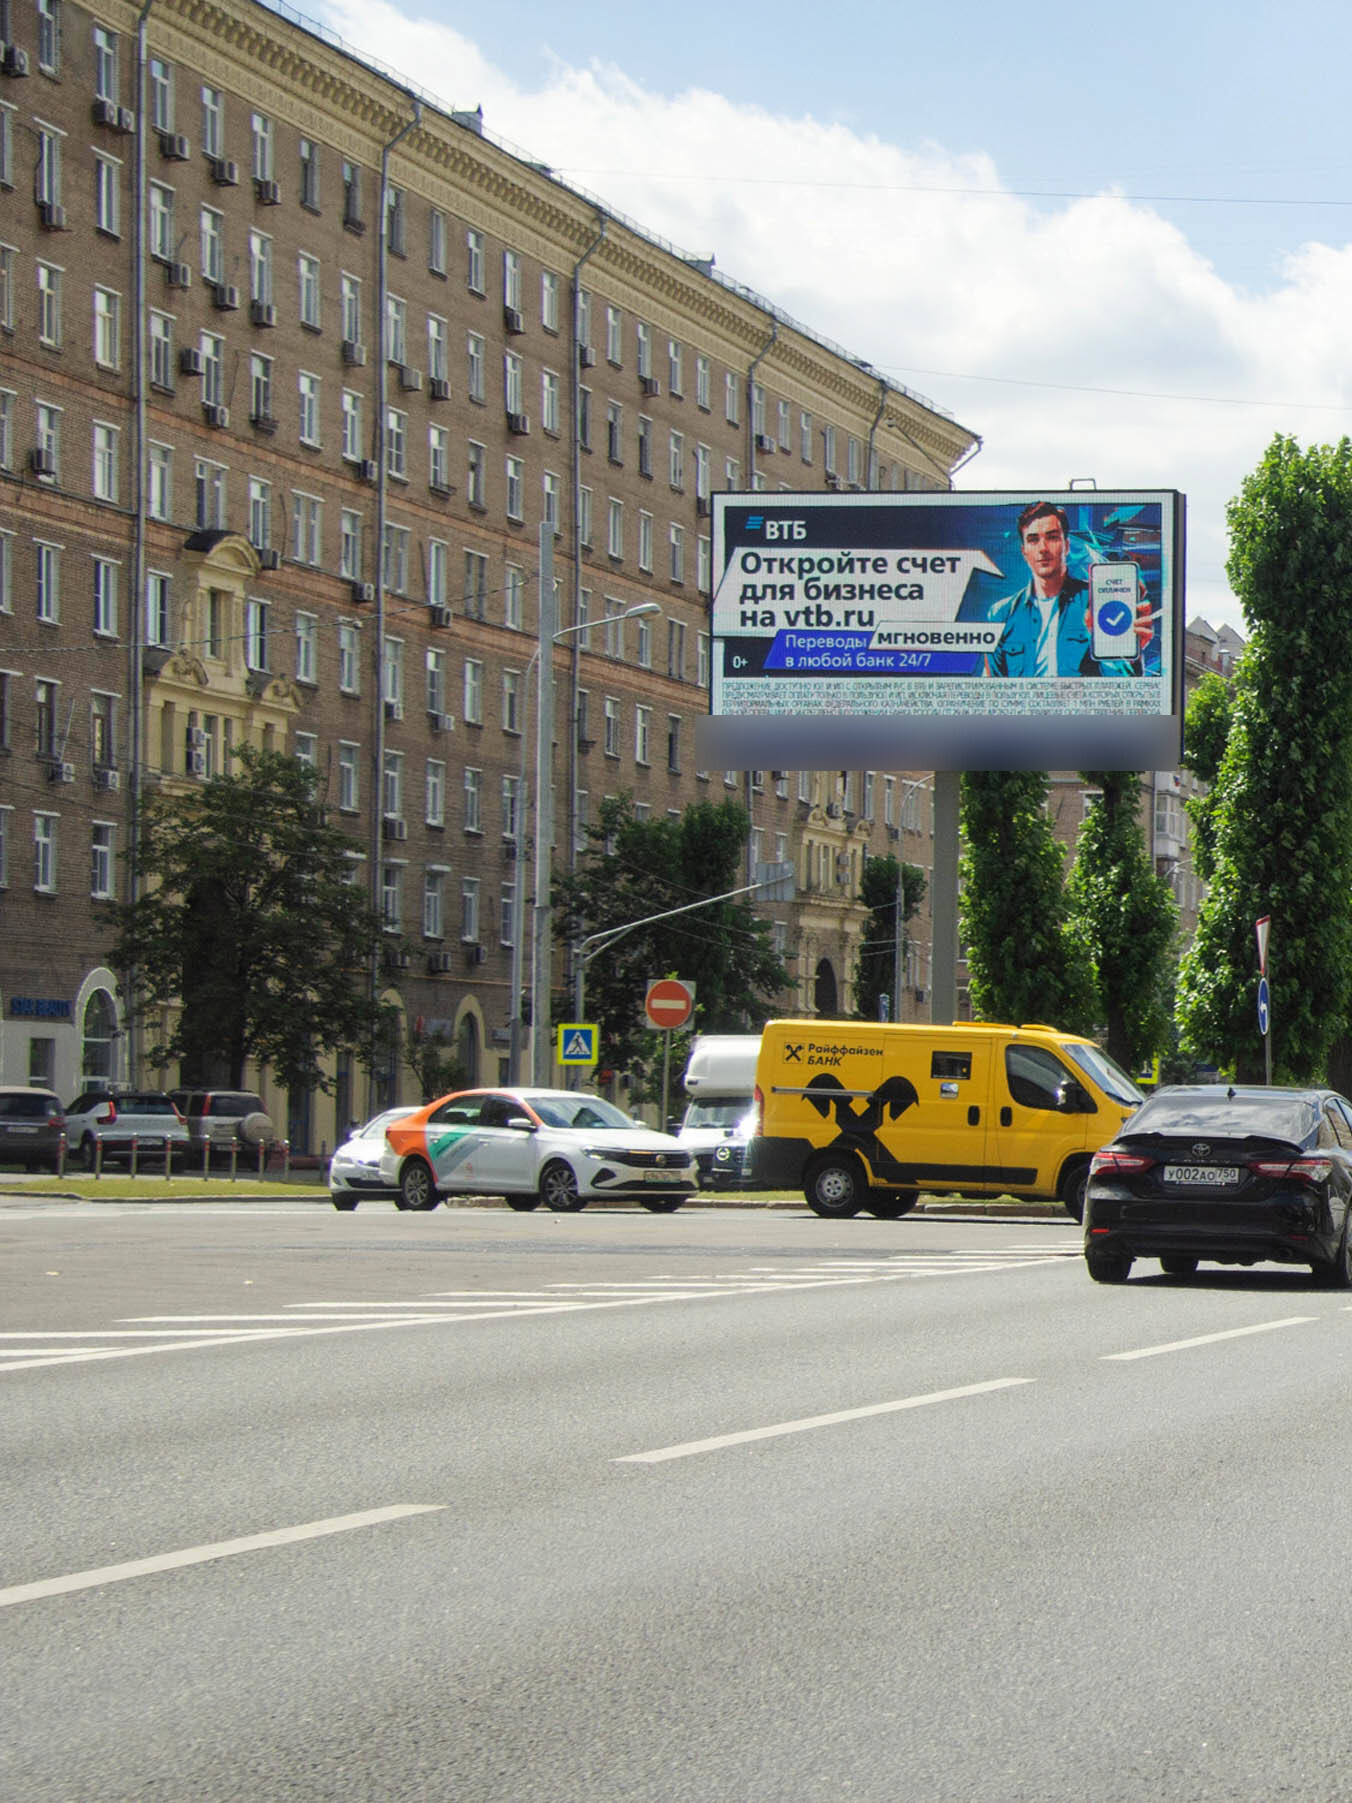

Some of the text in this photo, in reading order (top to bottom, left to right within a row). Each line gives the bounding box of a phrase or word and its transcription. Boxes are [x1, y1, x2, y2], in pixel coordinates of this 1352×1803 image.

[766, 520, 807, 540] ВТБ
[740, 551, 961, 580] Откройте счет
[739, 577, 925, 605] для бизнеса
[740, 603, 875, 627] на vtb.ru
[785, 634, 868, 650] Переводы
[877, 632, 997, 646] мгновенно
[732, 655, 749, 669] 0+
[785, 653, 932, 668] в любой банк 24/7
[808, 1043, 884, 1056] Райффайзен
[807, 1056, 842, 1066] БАНК
